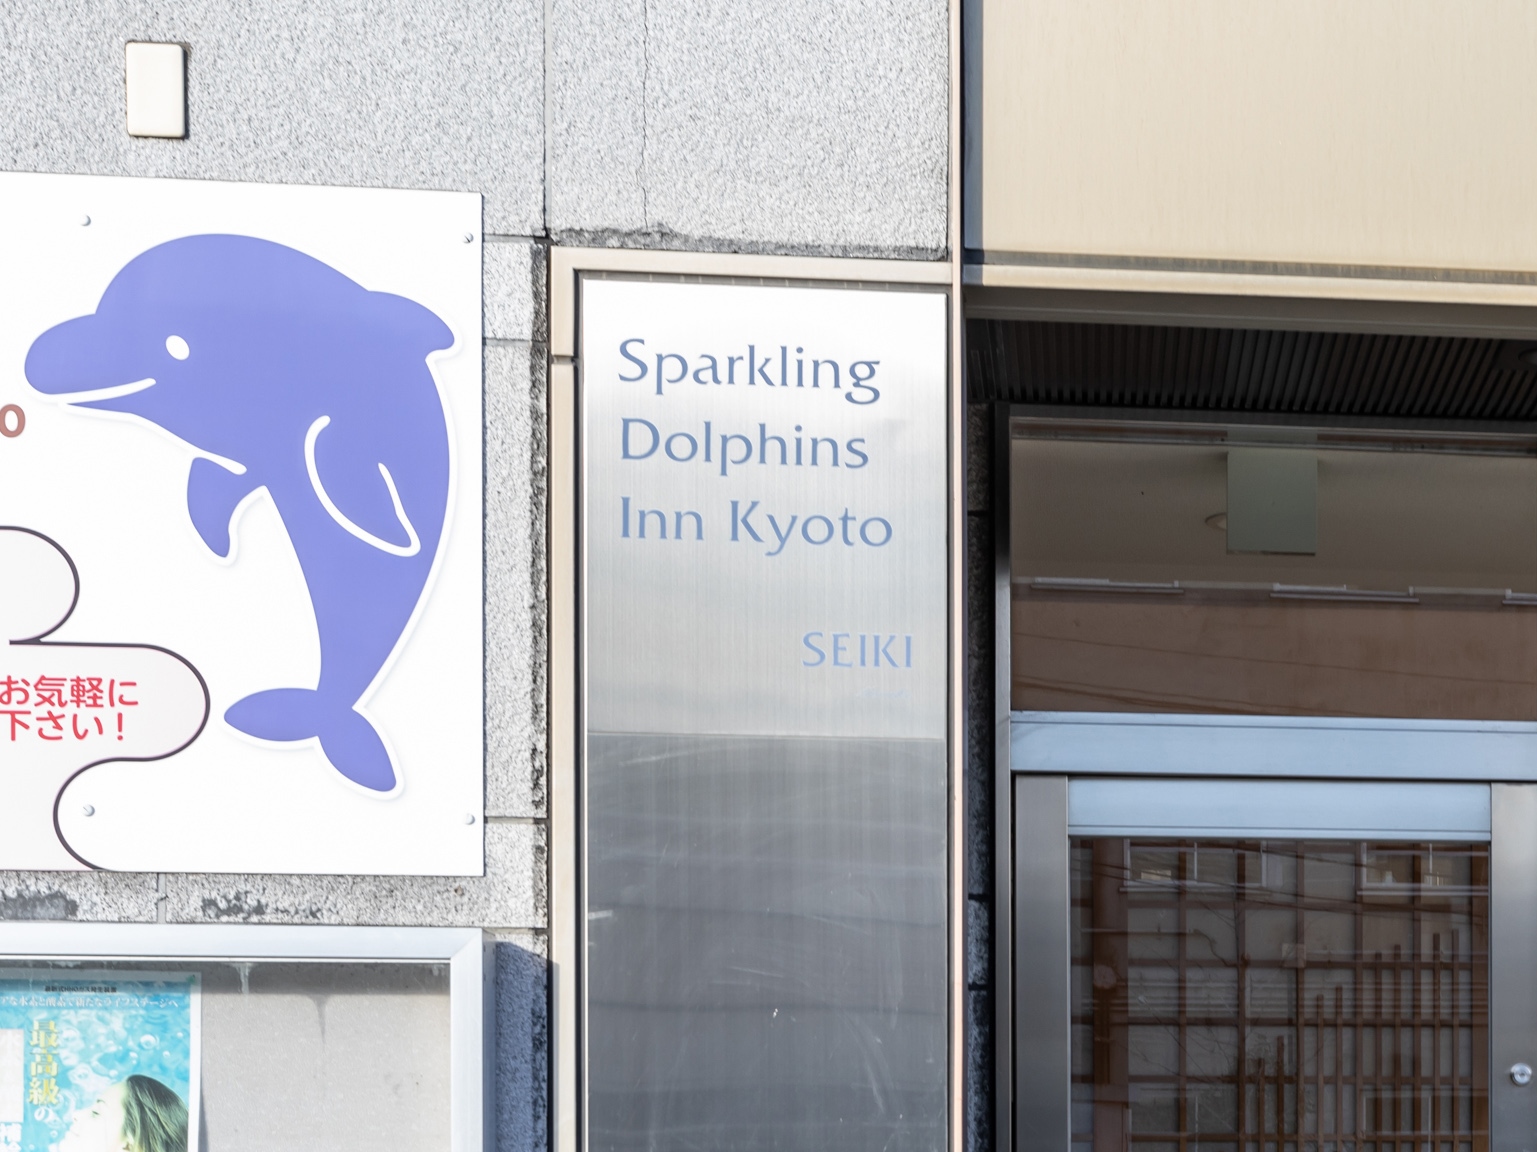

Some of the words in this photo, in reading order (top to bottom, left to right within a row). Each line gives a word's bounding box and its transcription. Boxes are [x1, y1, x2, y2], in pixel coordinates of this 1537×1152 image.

[618, 338, 880, 405] Sparkling
[620, 417, 869, 476] Dolphins
[620, 496, 704, 541] Inn
[729, 500, 893, 556] Kyoto
[801, 631, 912, 668] SEIKI
[0, 674, 139, 708] お気軽に
